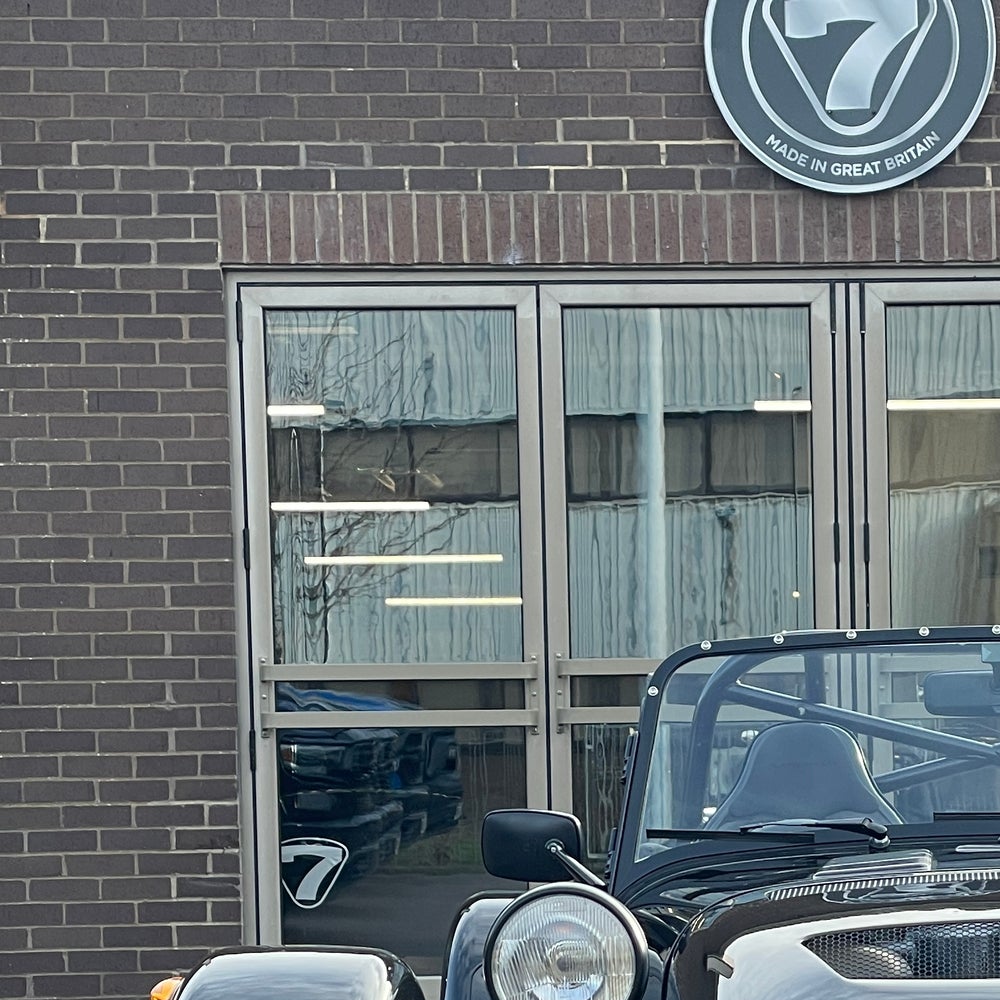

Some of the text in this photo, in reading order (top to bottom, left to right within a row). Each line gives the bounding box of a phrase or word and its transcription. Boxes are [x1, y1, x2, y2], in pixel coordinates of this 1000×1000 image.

[784, 0, 918, 109] 7
[765, 130, 941, 177] MADE IN GREAT BRITAIN
[281, 844, 343, 900] 7
